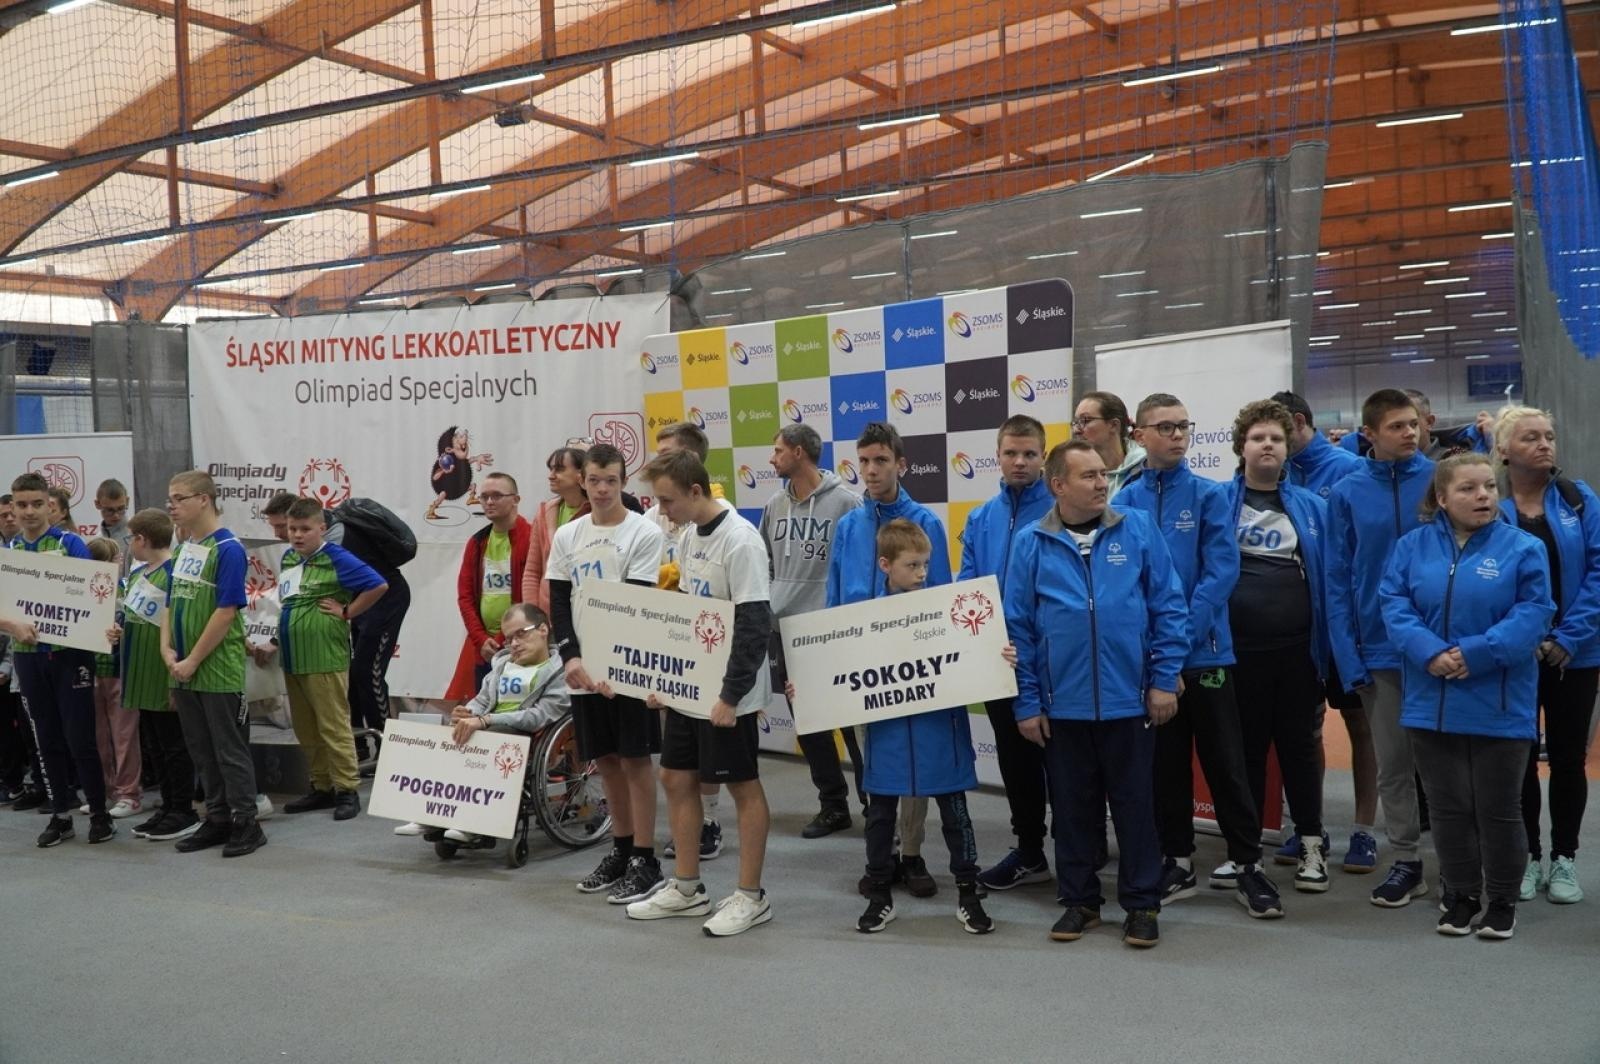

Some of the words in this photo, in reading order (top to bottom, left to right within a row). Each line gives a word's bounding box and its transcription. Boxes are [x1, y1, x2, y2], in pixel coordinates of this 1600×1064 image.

[972, 312, 1004, 326] ZSOMS
[853, 328, 881, 343] ZSOMS
[226, 336, 295, 373] ŚLĄSKI
[302, 335, 385, 364] MITYNG
[392, 320, 621, 360] LEKKOATLETYCZNY
[748, 344, 774, 356] ZSOMS
[295, 375, 392, 408] Olimpiad
[399, 369, 537, 405] Specjalnych
[1035, 378, 1069, 391] ZSOMS
[913, 391, 942, 404] ZSOMS
[802, 402, 828, 414] ZSOMS
[208, 463, 287, 481] Olimpiady
[974, 457, 1000, 469] ZSOM
[774, 517, 831, 543] DNM
[1, 564, 41, 579] Olimpiady
[44, 571, 86, 584] Specjalne
[181, 557, 203, 576] 123
[572, 560, 603, 587] 171
[132, 592, 158, 617] 119
[587, 598, 637, 617] Olimpiady
[640, 608, 692, 626] Specjalne
[791, 626, 863, 648] Olimpiady
[870, 610, 943, 632] Specjalne
[913, 626, 946, 641] Śląskie
[608, 666, 653, 689] PIEKARY
[656, 674, 700, 700] ŚLĄSKIE
[864, 682, 936, 710] MIEDARY
[388, 733, 437, 749] Olimpiady
[425, 801, 458, 818] WYRY
